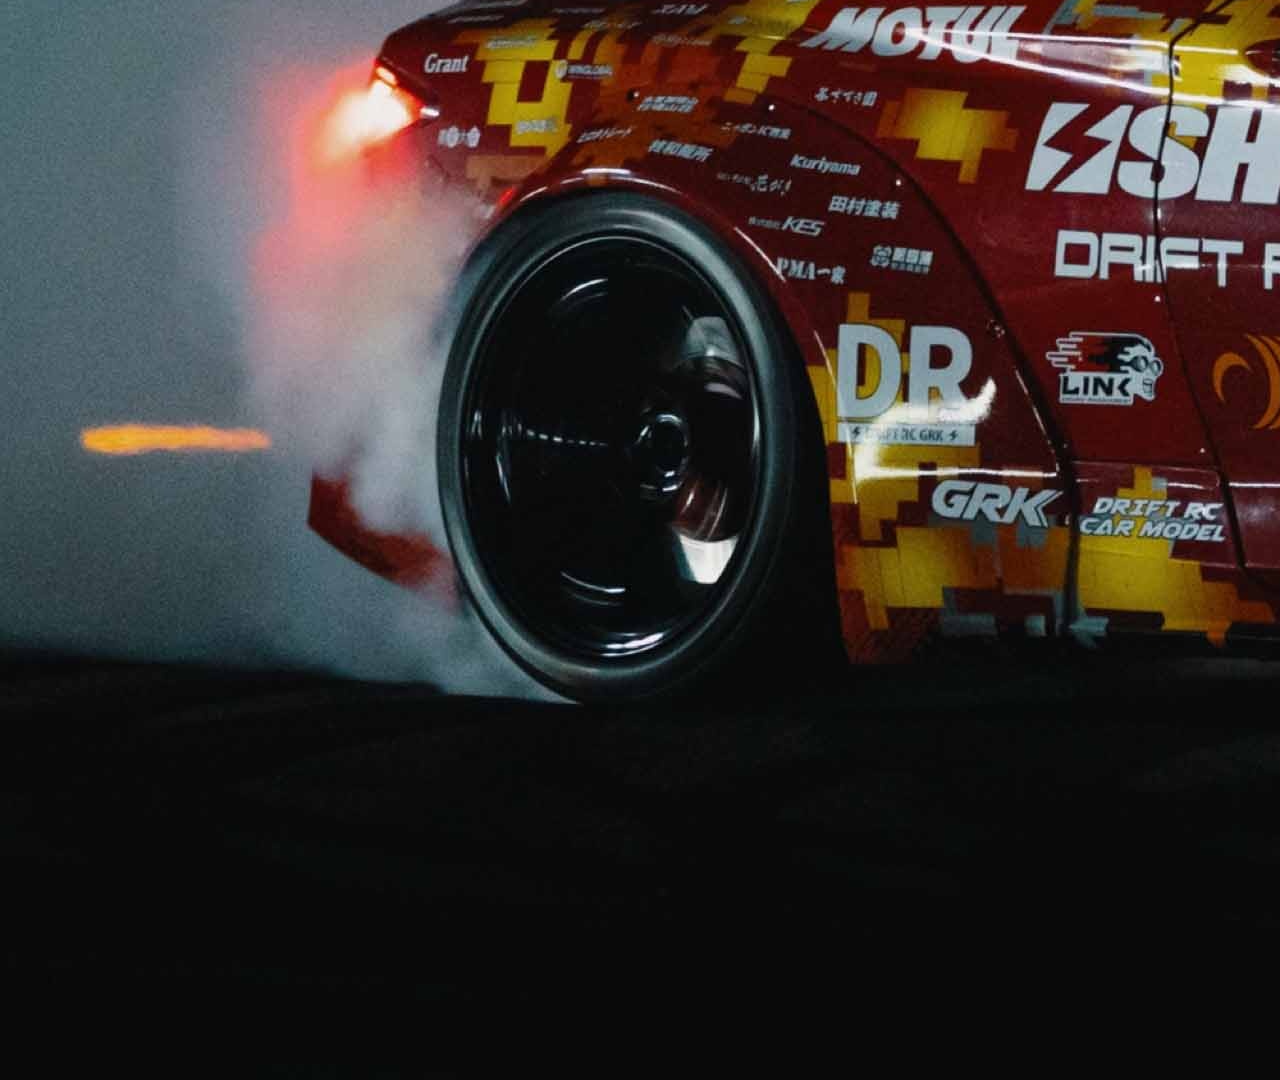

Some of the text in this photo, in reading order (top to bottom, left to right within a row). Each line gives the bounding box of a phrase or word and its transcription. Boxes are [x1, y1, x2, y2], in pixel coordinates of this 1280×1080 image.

[800, 5, 1027, 63] MOTUL
[424, 52, 470, 75] Grant
[790, 153, 861, 177] Kuriyama
[1054, 230, 1245, 289] DRIFT
[837, 323, 981, 421] DR
[931, 479, 1063, 528] GRK
[1093, 497, 1224, 520] DRIFT RC
[1079, 517, 1226, 543] CAR MODEL
